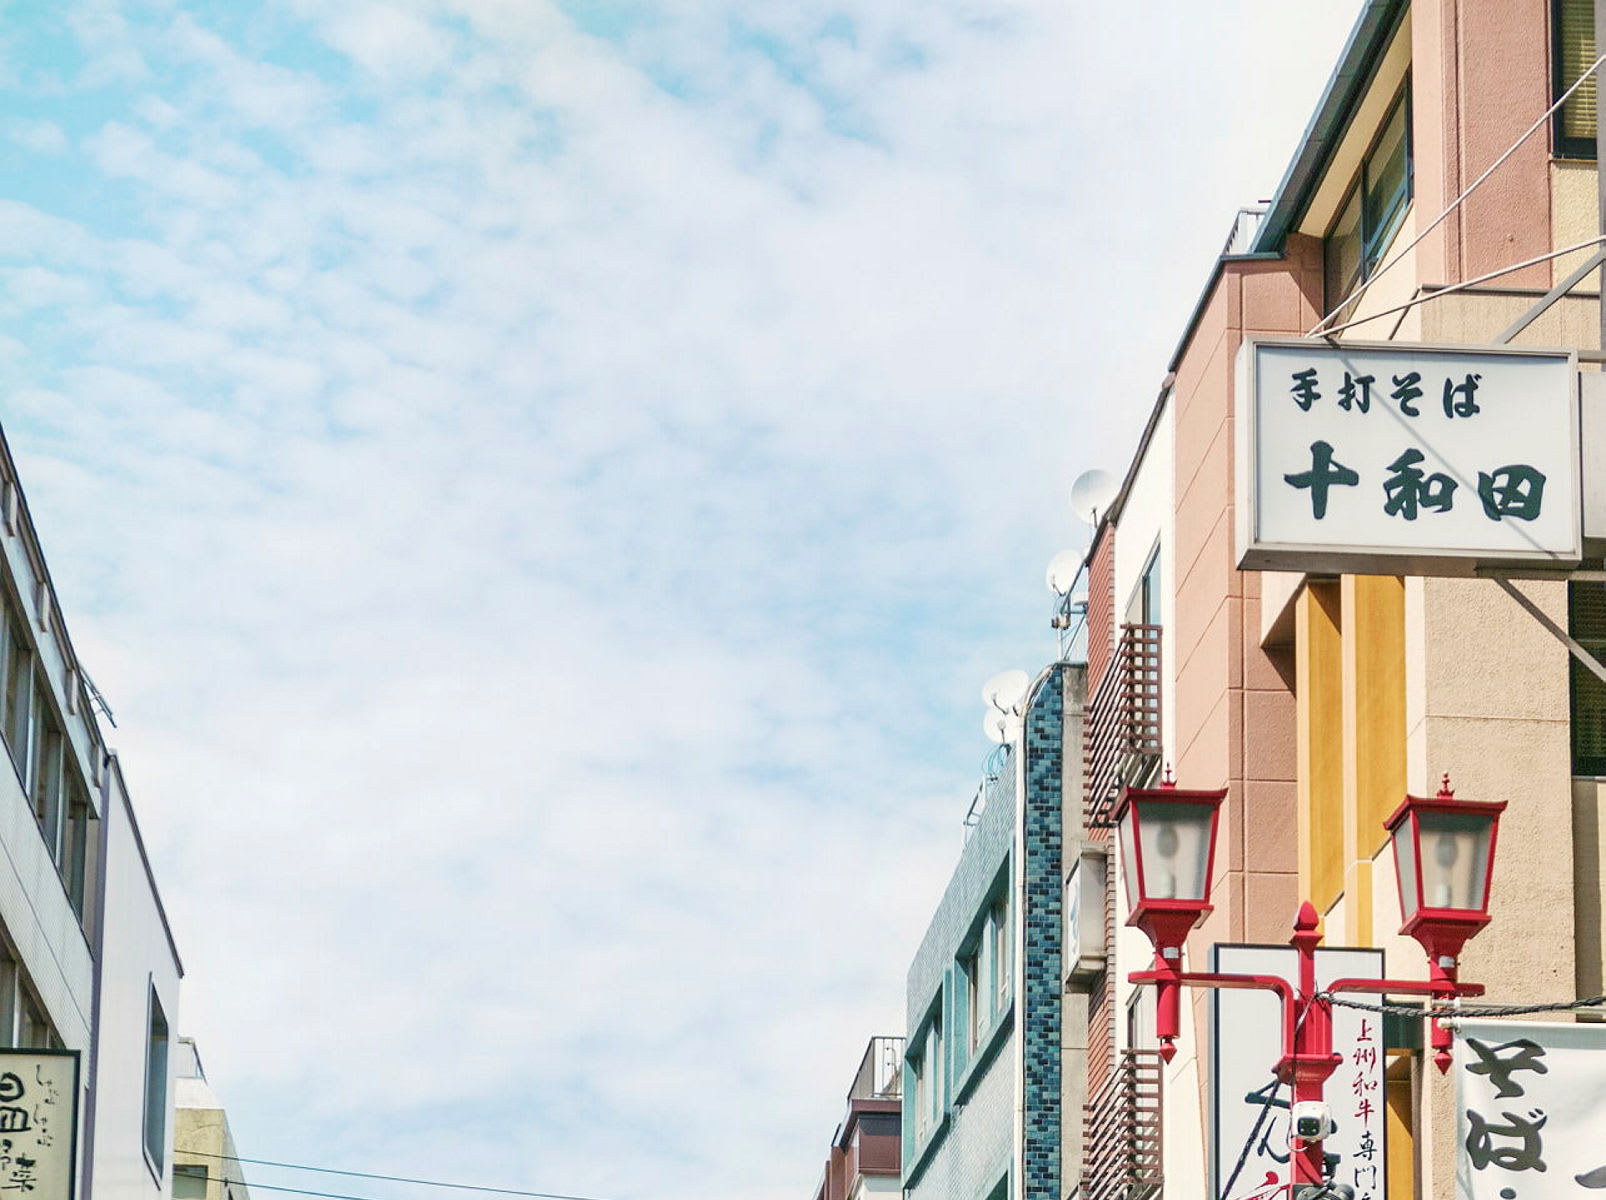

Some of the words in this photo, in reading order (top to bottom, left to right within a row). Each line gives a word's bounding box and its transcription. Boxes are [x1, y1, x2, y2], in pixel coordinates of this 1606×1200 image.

[1290, 368, 1482, 418] 手打そば
[1283, 439, 1547, 522] 十和田
